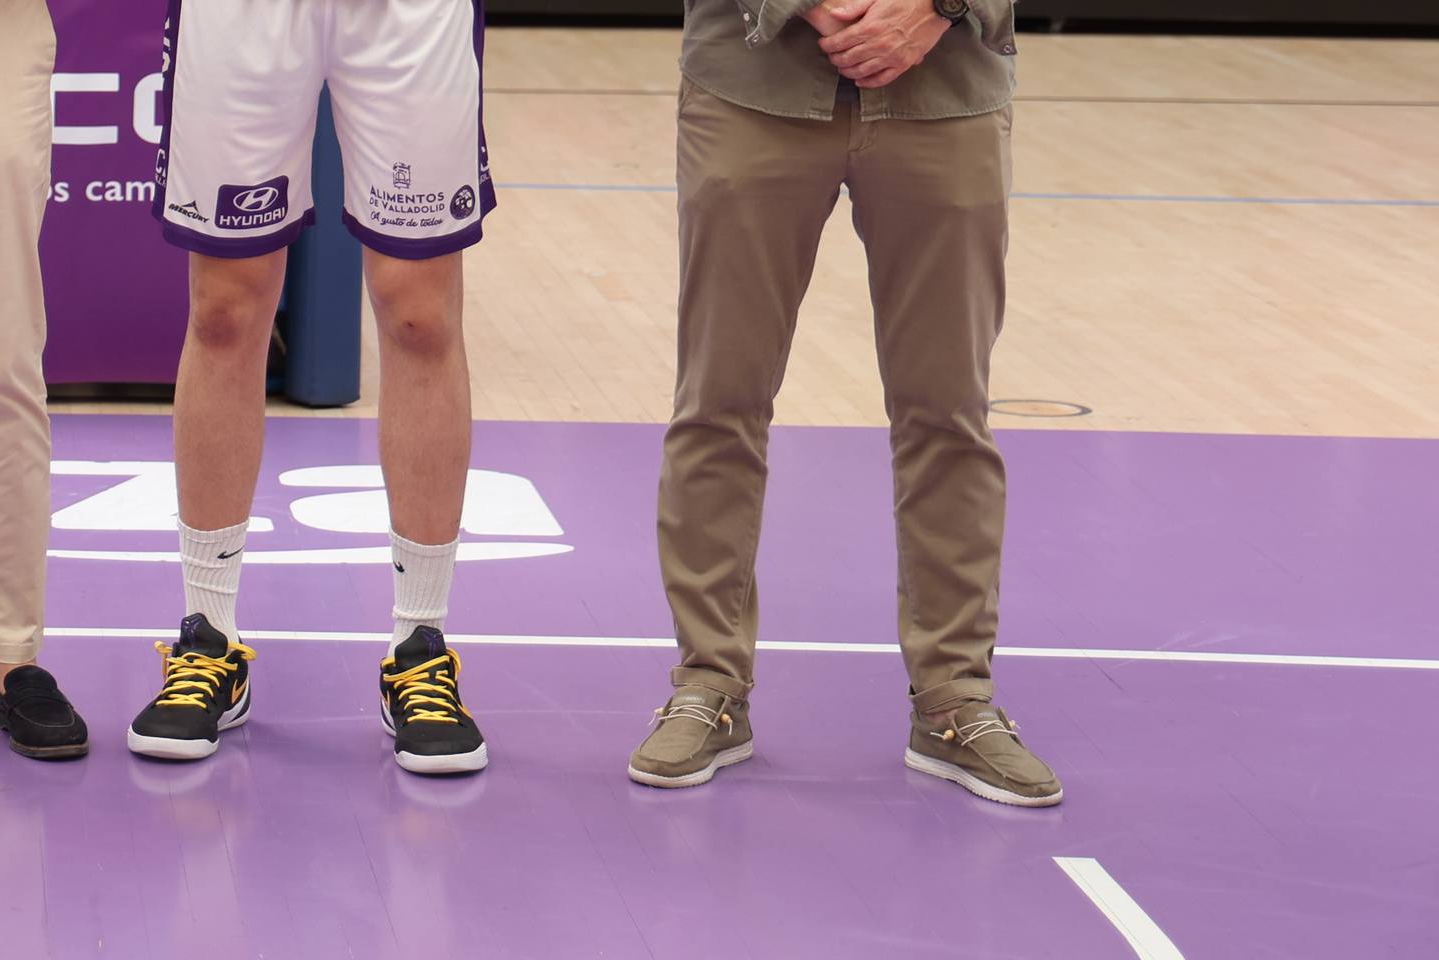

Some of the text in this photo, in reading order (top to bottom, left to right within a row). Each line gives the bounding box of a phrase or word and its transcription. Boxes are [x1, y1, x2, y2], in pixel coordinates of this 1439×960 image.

[369, 185, 445, 204] ALIMENTOS
[168, 203, 210, 224] MERCURY
[369, 197, 445, 214] DE VALLADOLID
[219, 207, 286, 226] HYUNDAI
[381, 216, 406, 227] gusto
[406, 218, 418, 227] de
[420, 217, 443, 227] todos
